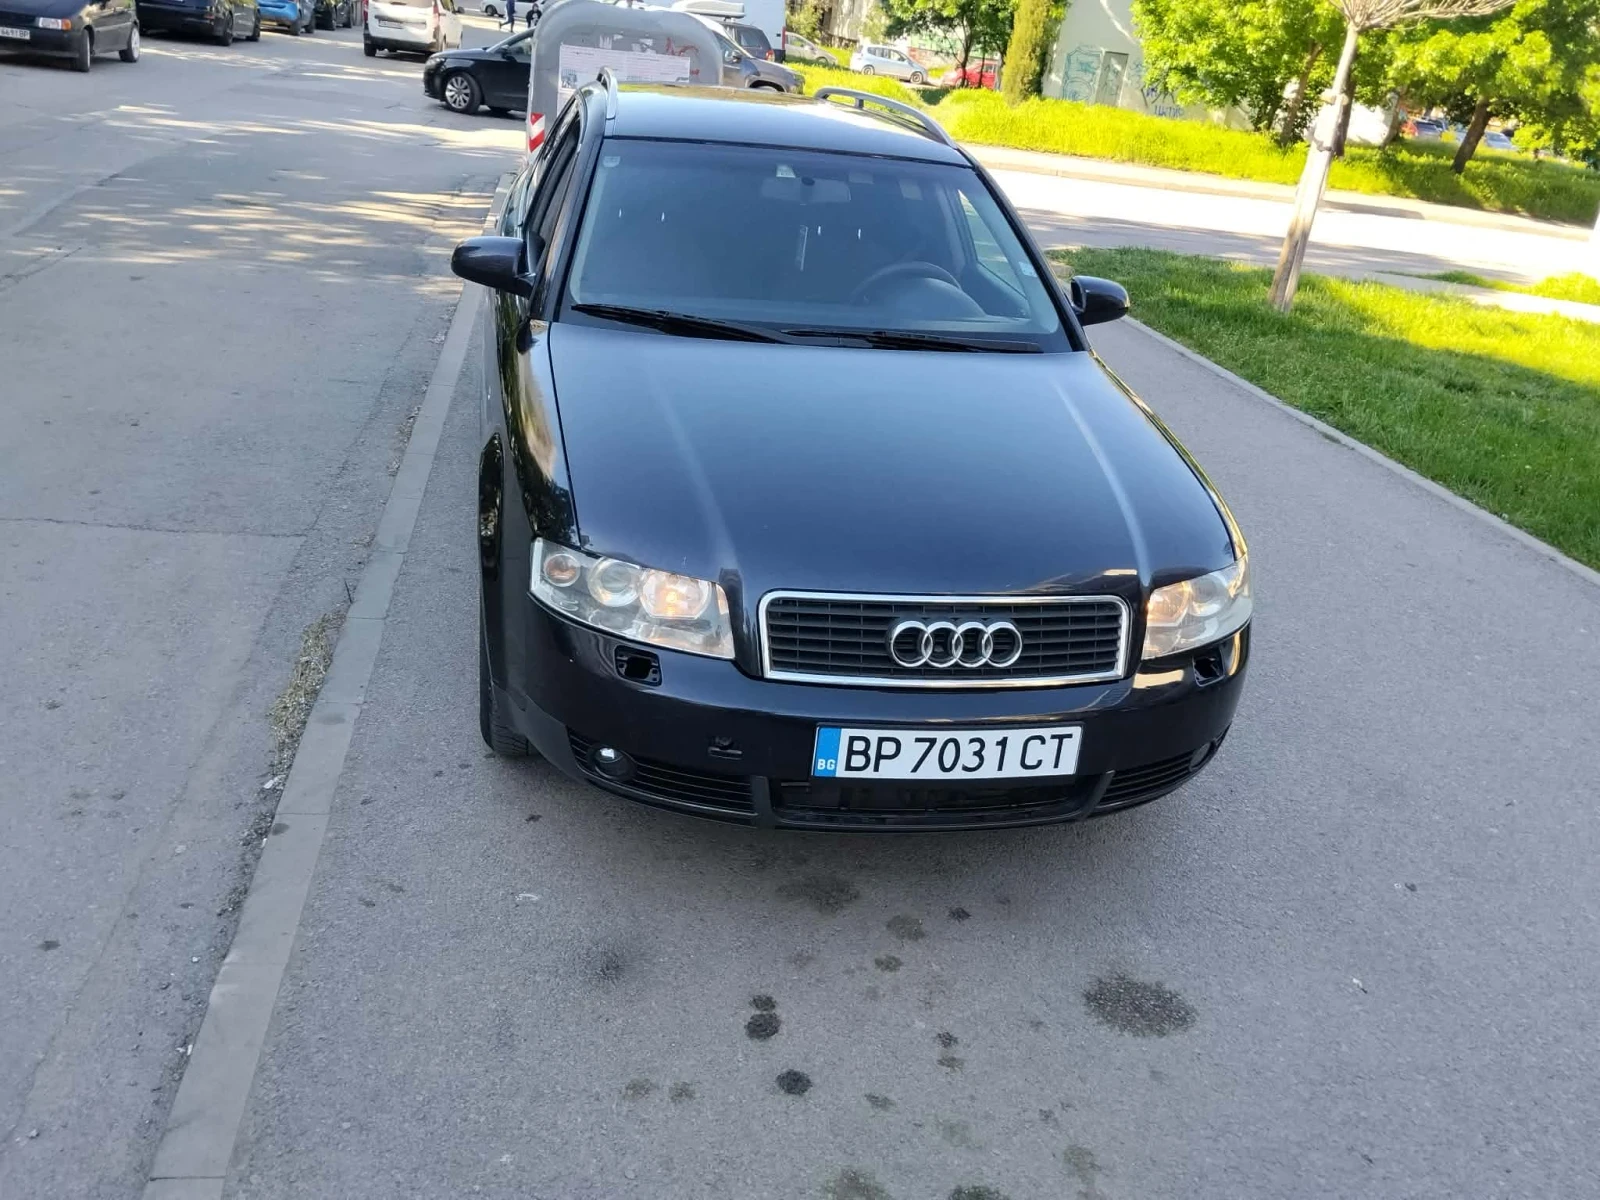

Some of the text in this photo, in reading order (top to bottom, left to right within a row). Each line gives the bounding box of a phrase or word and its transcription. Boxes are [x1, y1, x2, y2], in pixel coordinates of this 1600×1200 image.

[817, 758, 836, 771] BG
[844, 733, 1073, 773] BP 7031 CT
